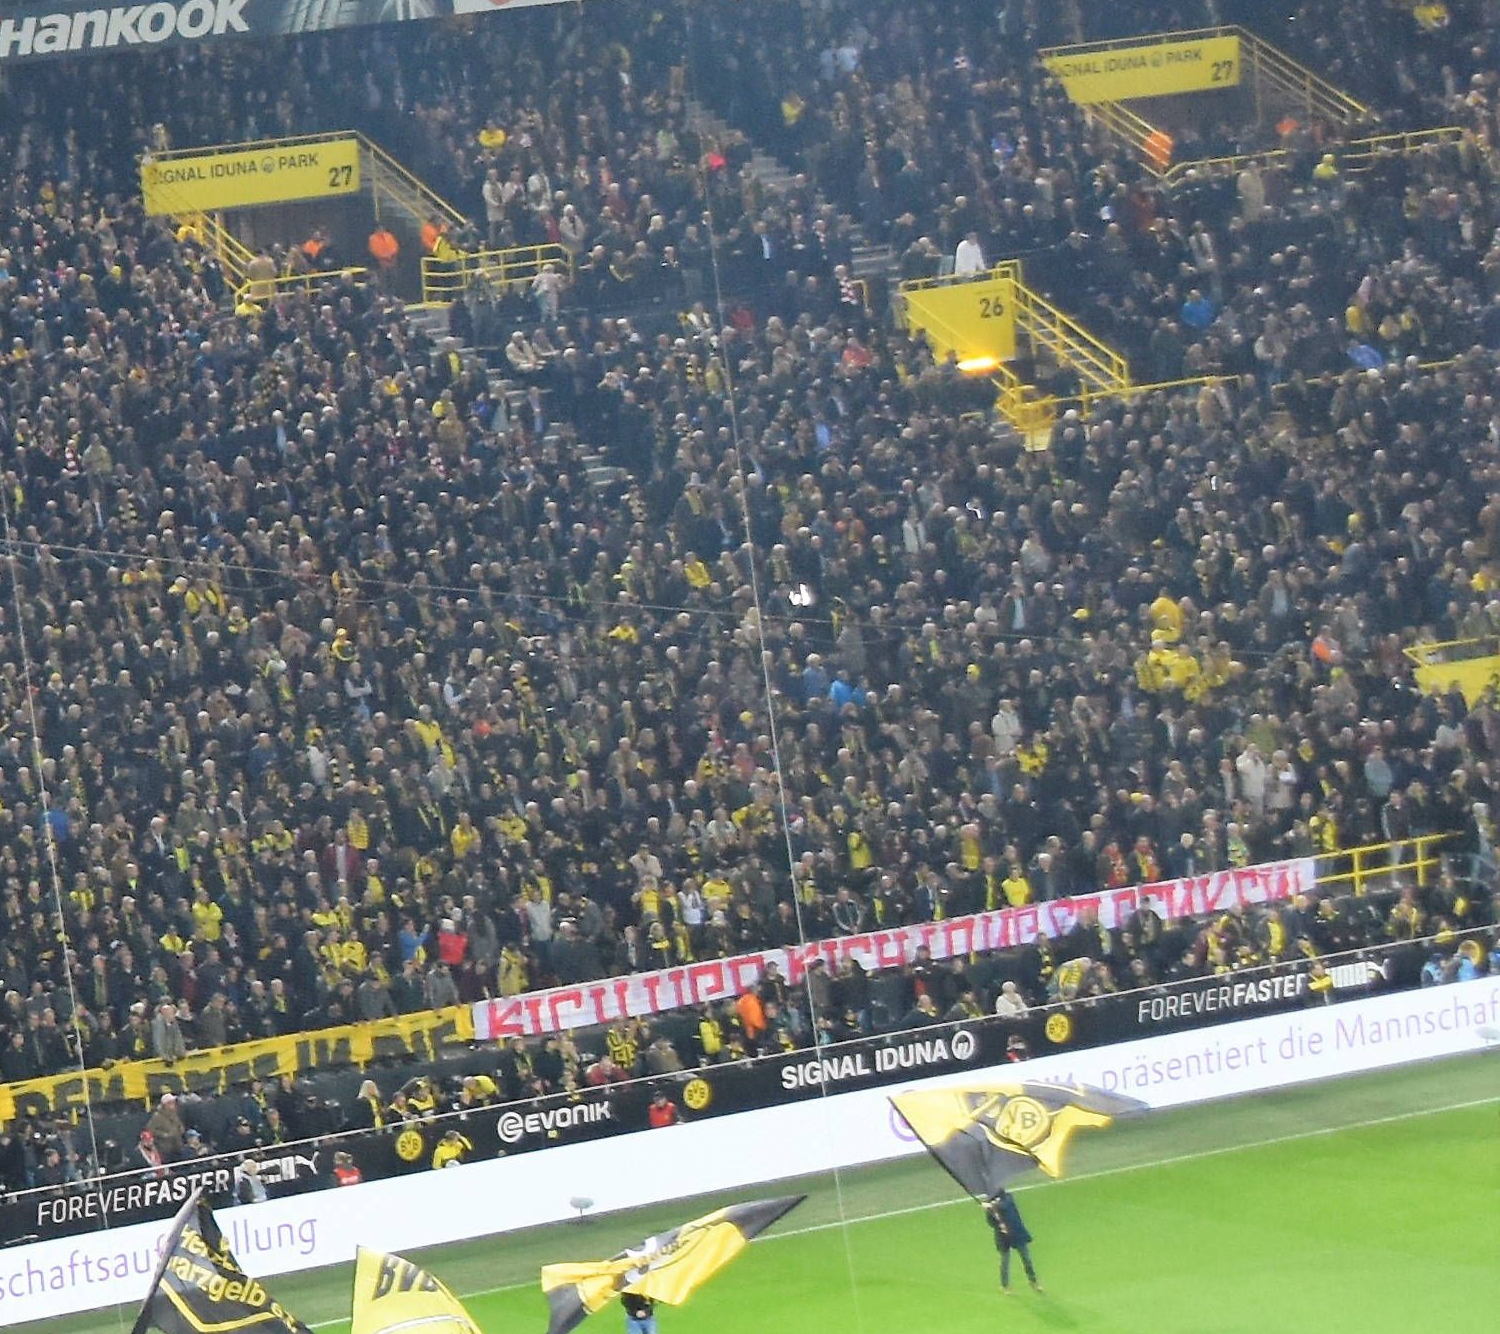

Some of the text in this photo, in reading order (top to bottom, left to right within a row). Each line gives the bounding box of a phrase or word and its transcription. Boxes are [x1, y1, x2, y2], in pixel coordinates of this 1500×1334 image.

[1211, 59, 1233, 82] 27
[211, 159, 258, 179] IDUNA
[278, 152, 319, 171] PARK
[328, 164, 352, 188] 27
[979, 295, 1005, 318] 26
[1102, 993, 1500, 1098] präsentiert die Mannschaf
[782, 1045, 949, 1090] SIGNAL IDUNA
[524, 1100, 610, 1134] EVONIK
